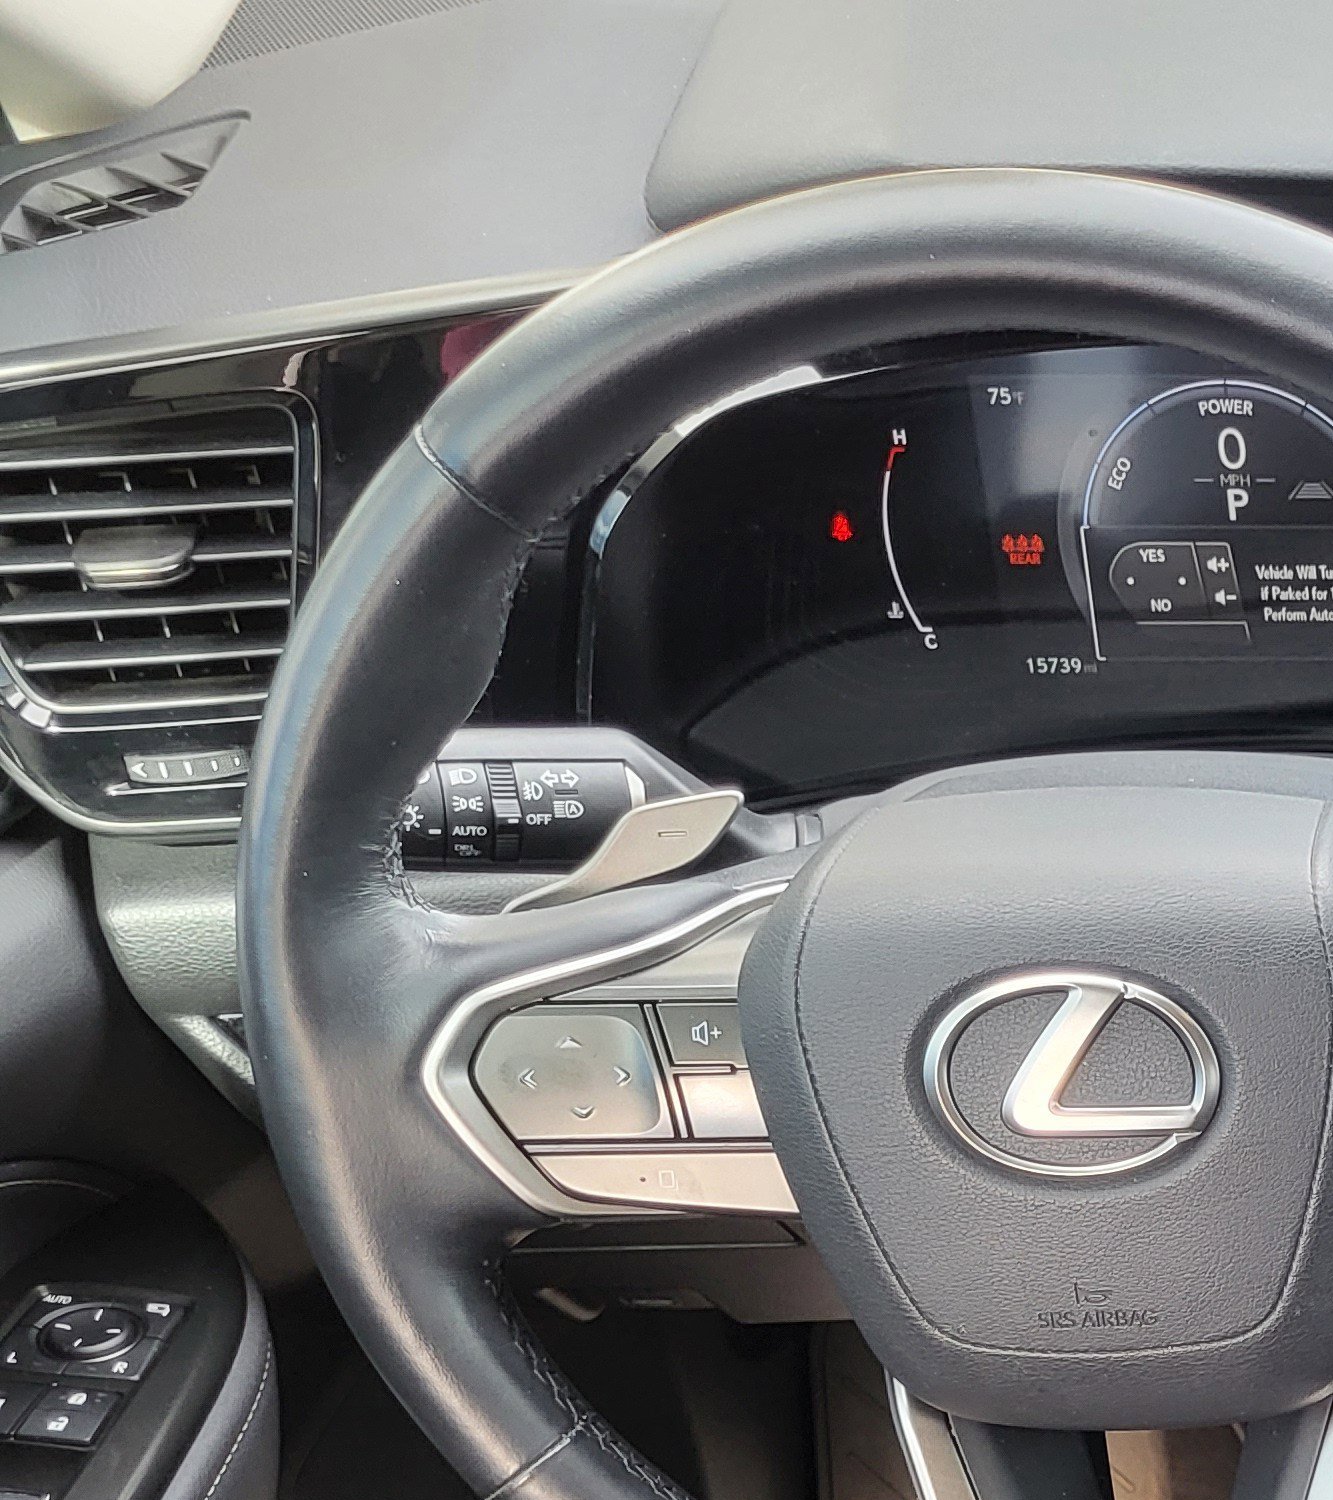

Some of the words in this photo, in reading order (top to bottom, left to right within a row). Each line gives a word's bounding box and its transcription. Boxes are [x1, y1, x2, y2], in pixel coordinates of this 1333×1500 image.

[1197, 398, 1254, 417] POWER
[891, 429, 907, 445] H
[1217, 427, 1247, 470] 0
[1107, 456, 1133, 491] ECO
[1219, 473, 1251, 488] MPH
[1226, 488, 1250, 521] P
[1138, 548, 1166, 563] YES
[1254, 564, 1294, 581] Vehicle
[1295, 564, 1318, 581] Will
[1271, 585, 1310, 602] Parked
[1311, 585, 1328, 602] for
[1150, 598, 1172, 613] NO
[1263, 606, 1308, 622] Perform
[923, 634, 939, 651] C
[1025, 657, 1082, 674] 15739
[525, 813, 553, 826] OFF
[452, 825, 488, 837] AUTO
[42, 1294, 72, 1304] AUTO
[1037, 1311, 1076, 1329] SRS
[1081, 1310, 1158, 1329] AIRBAG
